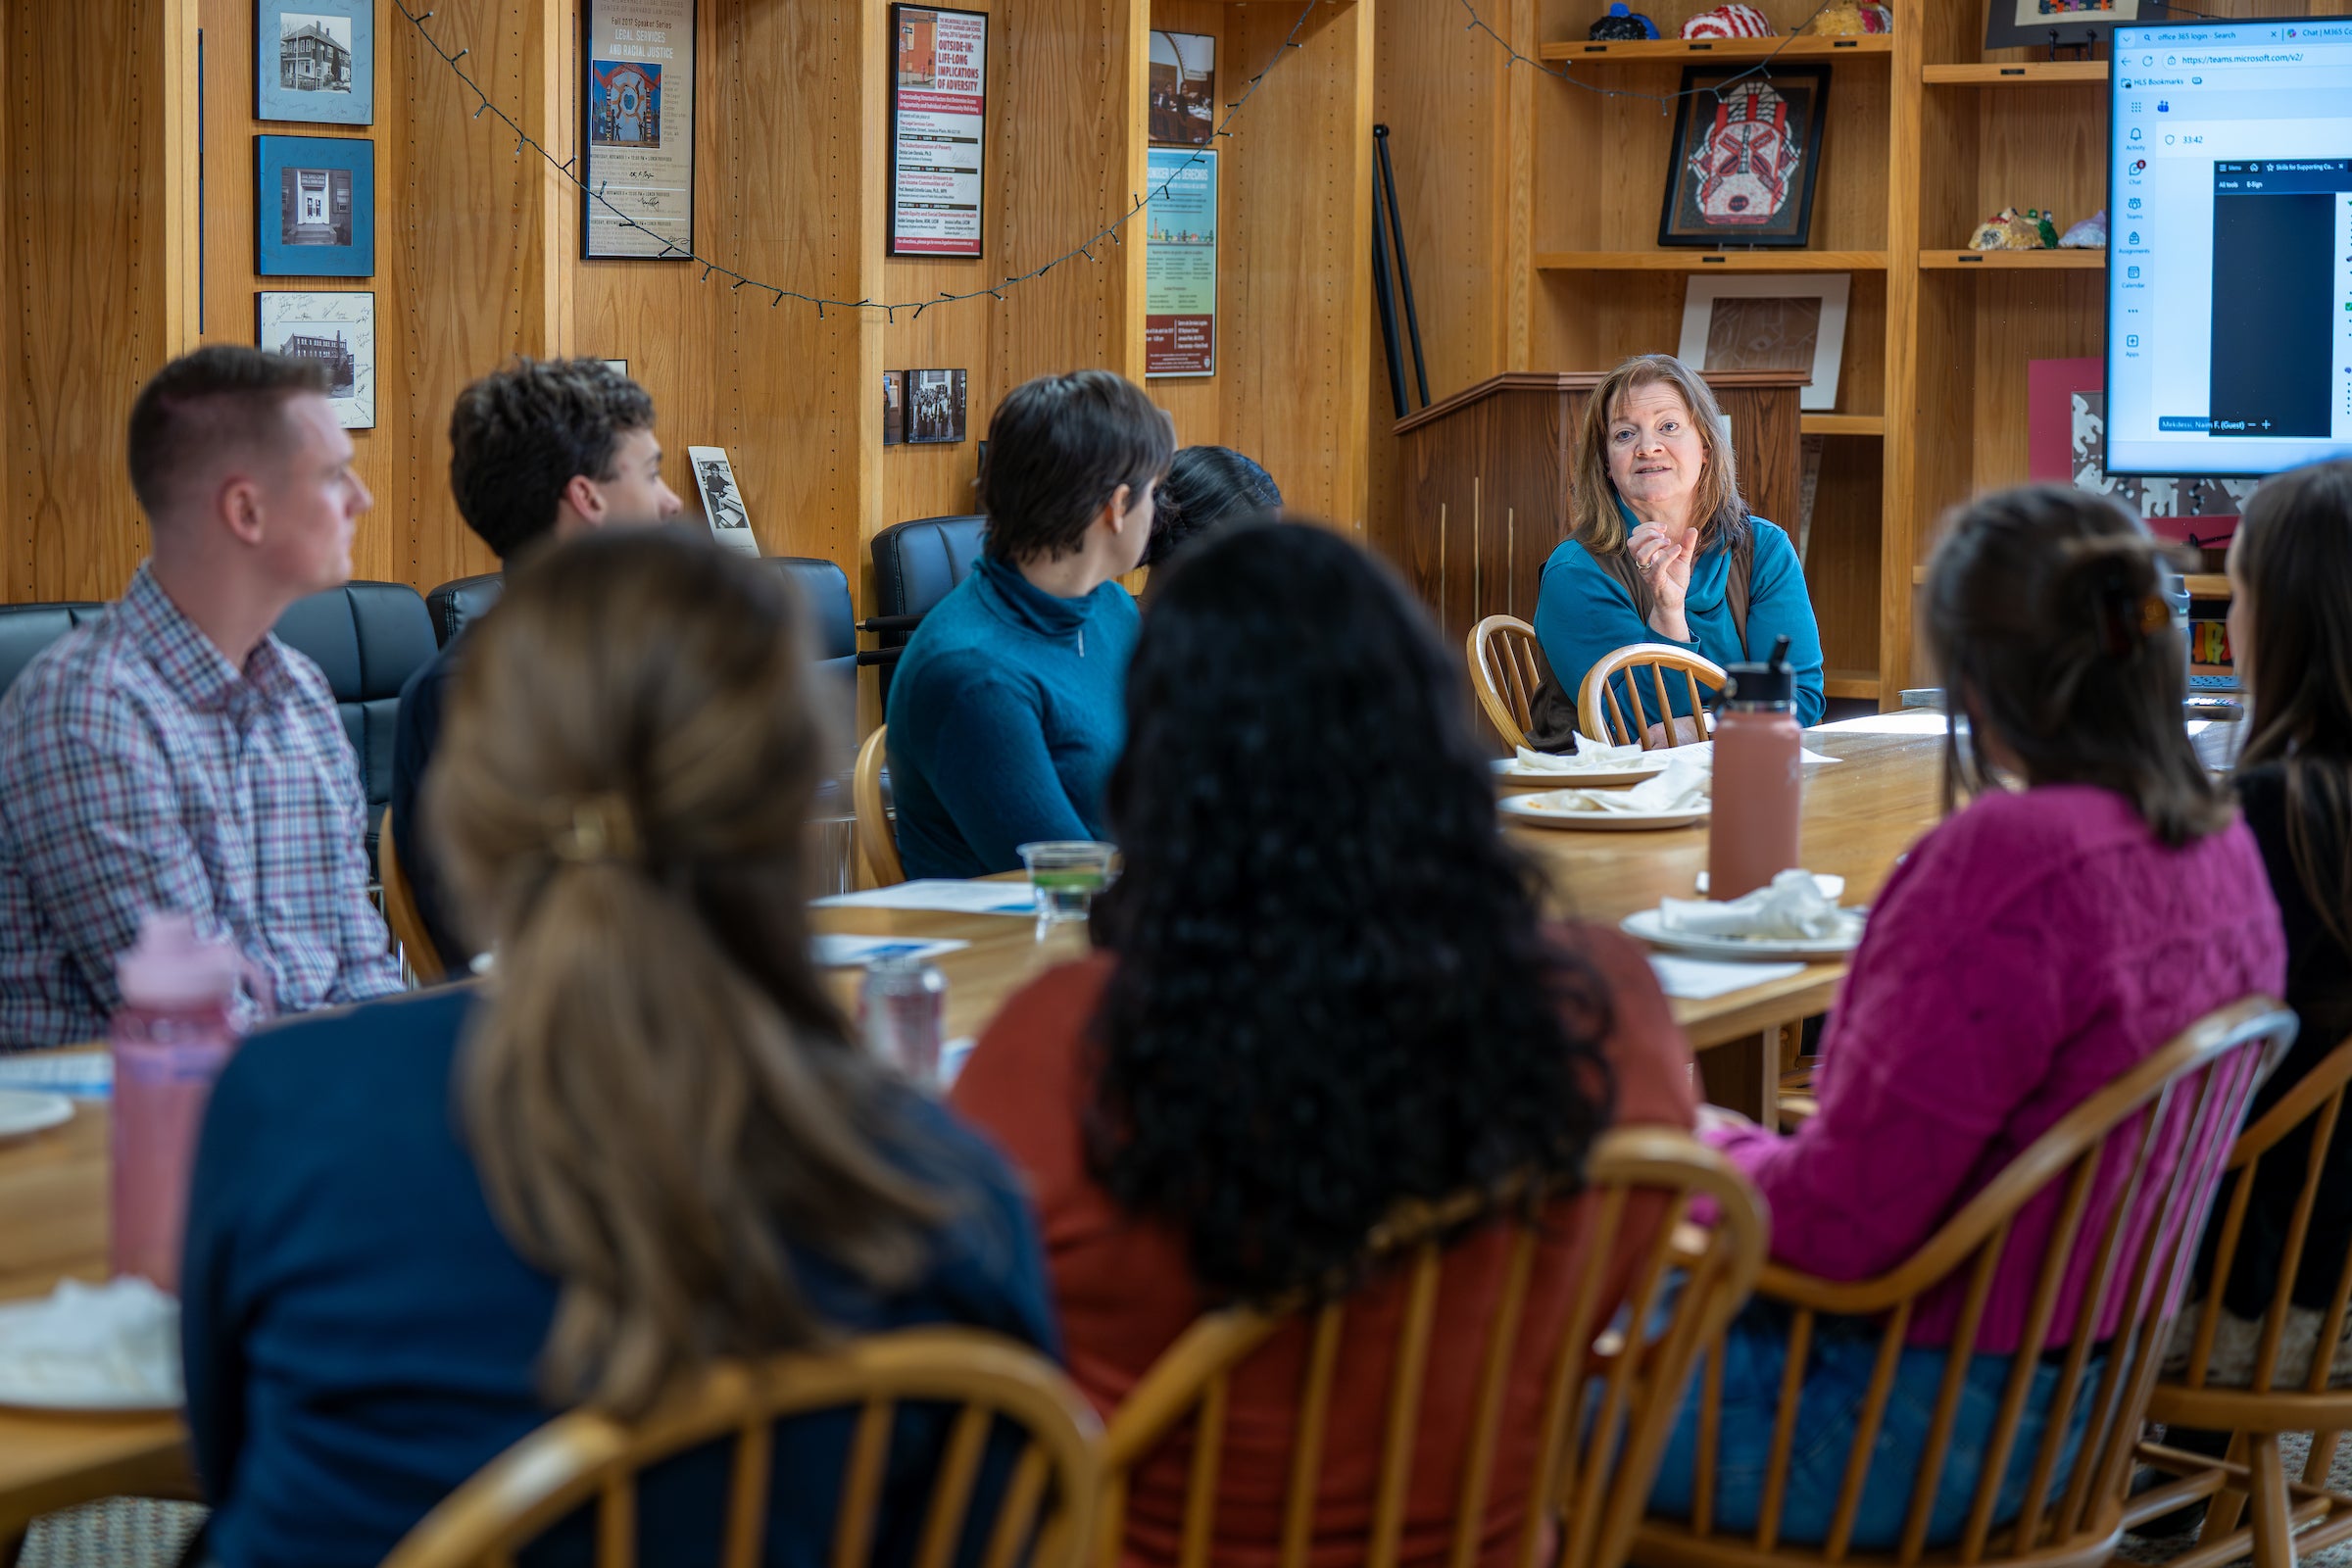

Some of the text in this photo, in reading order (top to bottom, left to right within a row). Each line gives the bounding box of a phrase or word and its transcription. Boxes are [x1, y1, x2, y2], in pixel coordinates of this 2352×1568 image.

[612, 17, 621, 25] Fall
[635, 19, 654, 28] Speaker
[656, 20, 672, 29] Series
[615, 29, 666, 43] LEGAL SERVICES
[939, 30, 948, 38] Spring
[2191, 32, 2207, 41] login
[609, 43, 673, 59] AND RACIAL JUSTICE
[939, 40, 974, 52] OUTSIDE-IN:
[938, 52, 968, 65] LIFE-LONG
[2182, 53, 2303, 65] https://teams.microsoft.com/v2/
[938, 65, 979, 79] IMPLICATIONS
[937, 78, 978, 92] OF ADVERSITY
[2148, 77, 2183, 86] Bookmarks
[2221, 420, 2245, 430] (Guest)
